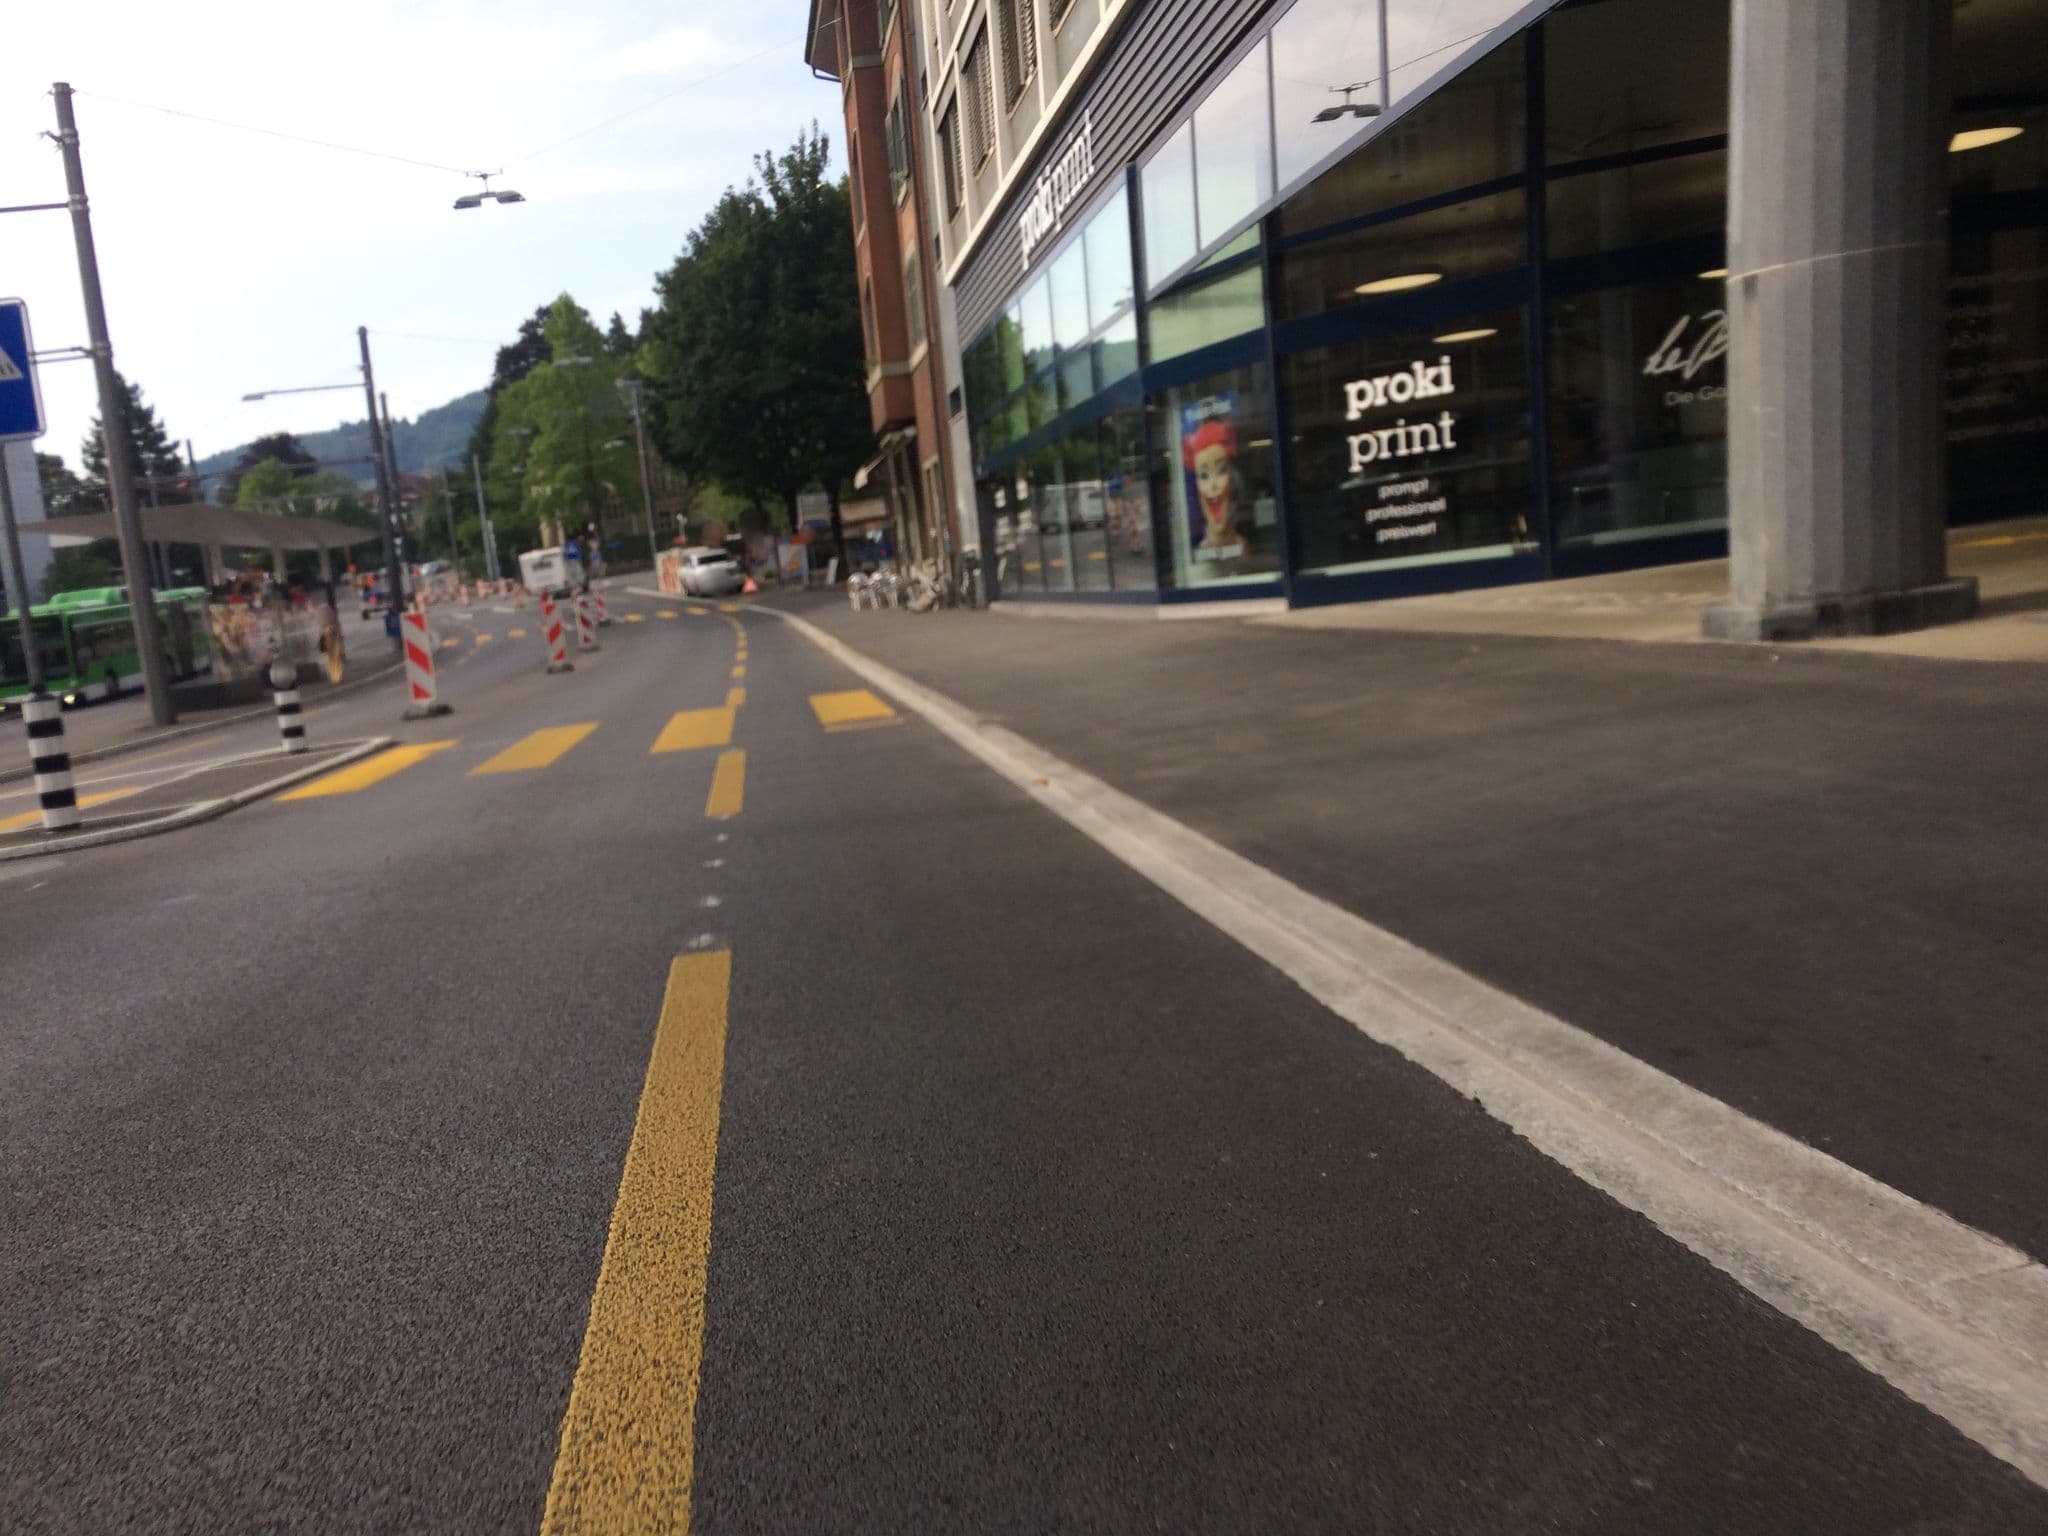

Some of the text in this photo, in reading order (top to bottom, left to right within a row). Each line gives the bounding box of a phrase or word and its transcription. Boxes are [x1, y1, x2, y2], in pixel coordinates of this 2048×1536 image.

[1344, 355, 1455, 420] proki
[1346, 410, 1457, 473] print
[1378, 478, 1429, 499] prompt
